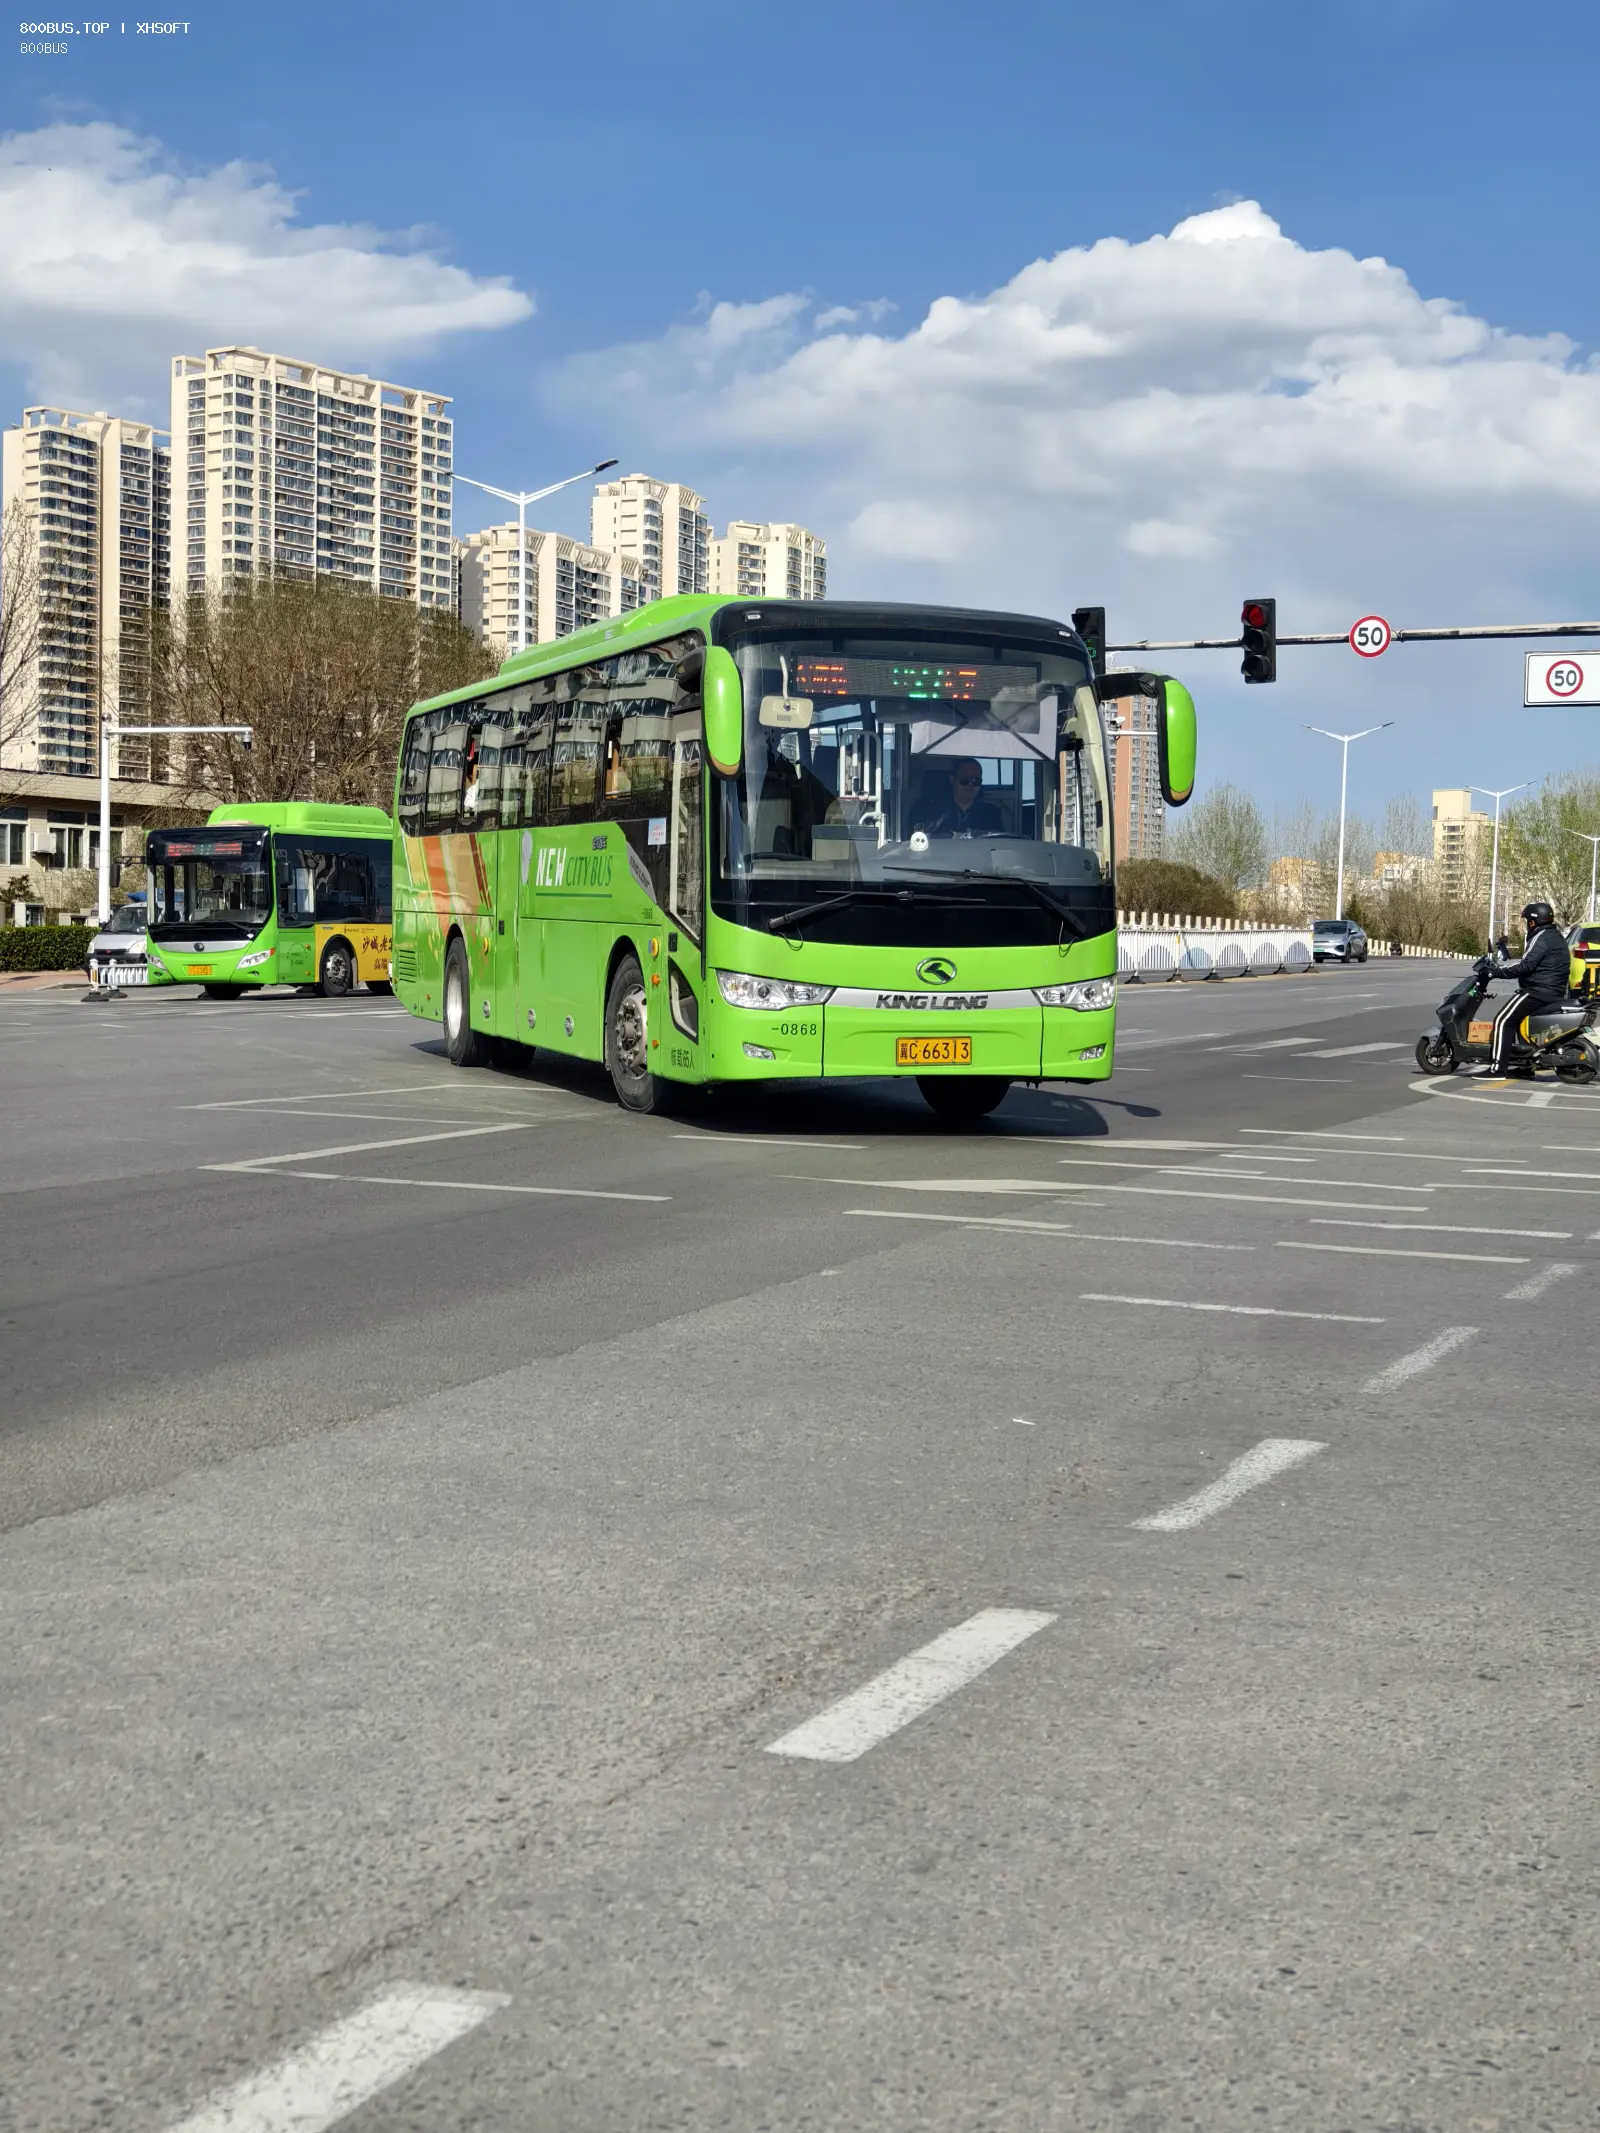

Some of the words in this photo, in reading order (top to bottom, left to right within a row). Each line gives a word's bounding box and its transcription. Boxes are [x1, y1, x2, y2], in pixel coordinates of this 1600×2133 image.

[1357, 626, 1383, 647] 50
[1554, 669, 1578, 687] 50
[536, 847, 567, 886] NEW
[875, 994, 929, 1010] KING
[930, 995, 989, 1010] LONG
[771, 1023, 817, 1036] -0868
